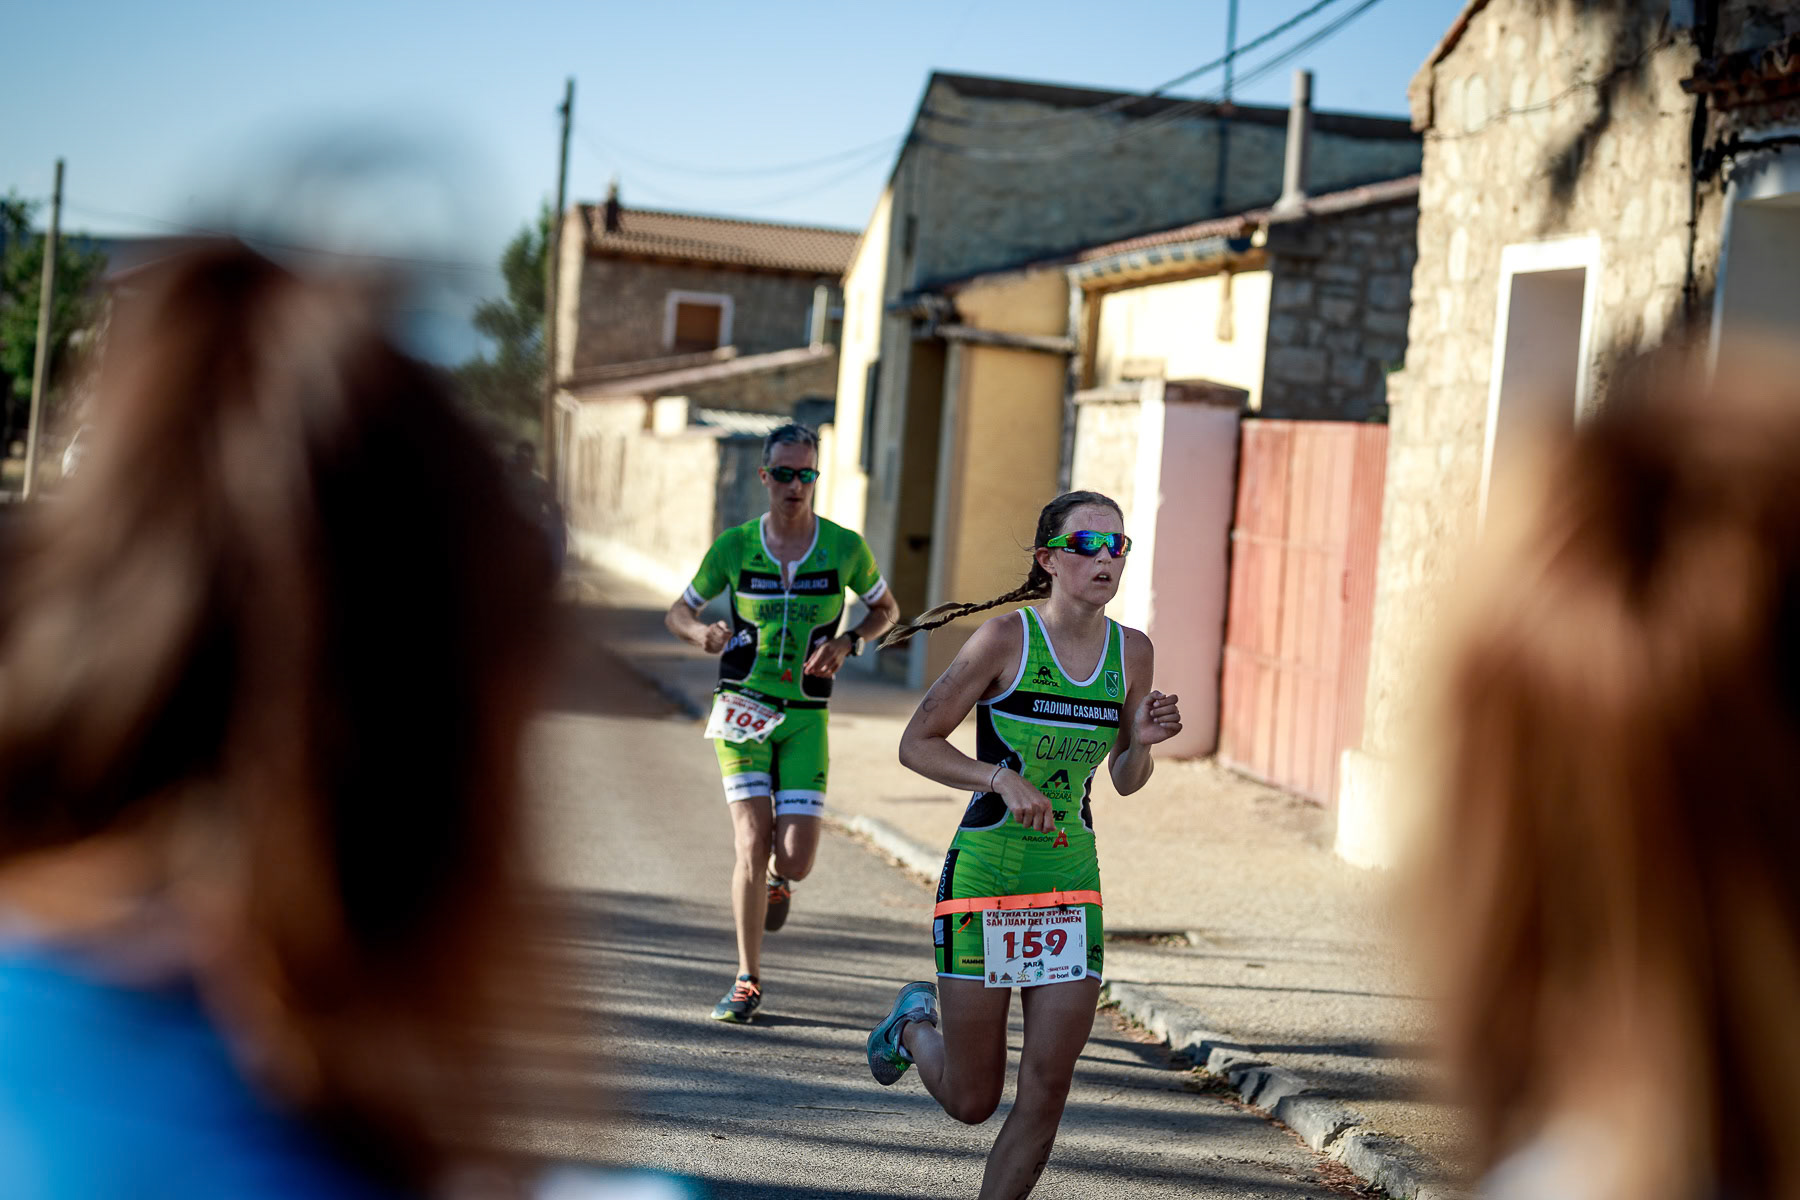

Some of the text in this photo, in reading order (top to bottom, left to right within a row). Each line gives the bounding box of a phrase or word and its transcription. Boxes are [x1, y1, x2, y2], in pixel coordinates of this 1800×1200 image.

[725, 708, 767, 732] 104
[1032, 699, 1119, 722] STADIUM CASABLANCA
[1036, 734, 1107, 764] CLAVERO
[1022, 835, 1053, 843] ARAGÓN
[986, 916, 1082, 927] SAN JUAN DEL FLUMEN
[1001, 910, 1045, 918] TRIATLON
[1046, 909, 1082, 917] SPRINT
[1003, 928, 1068, 959] 159
